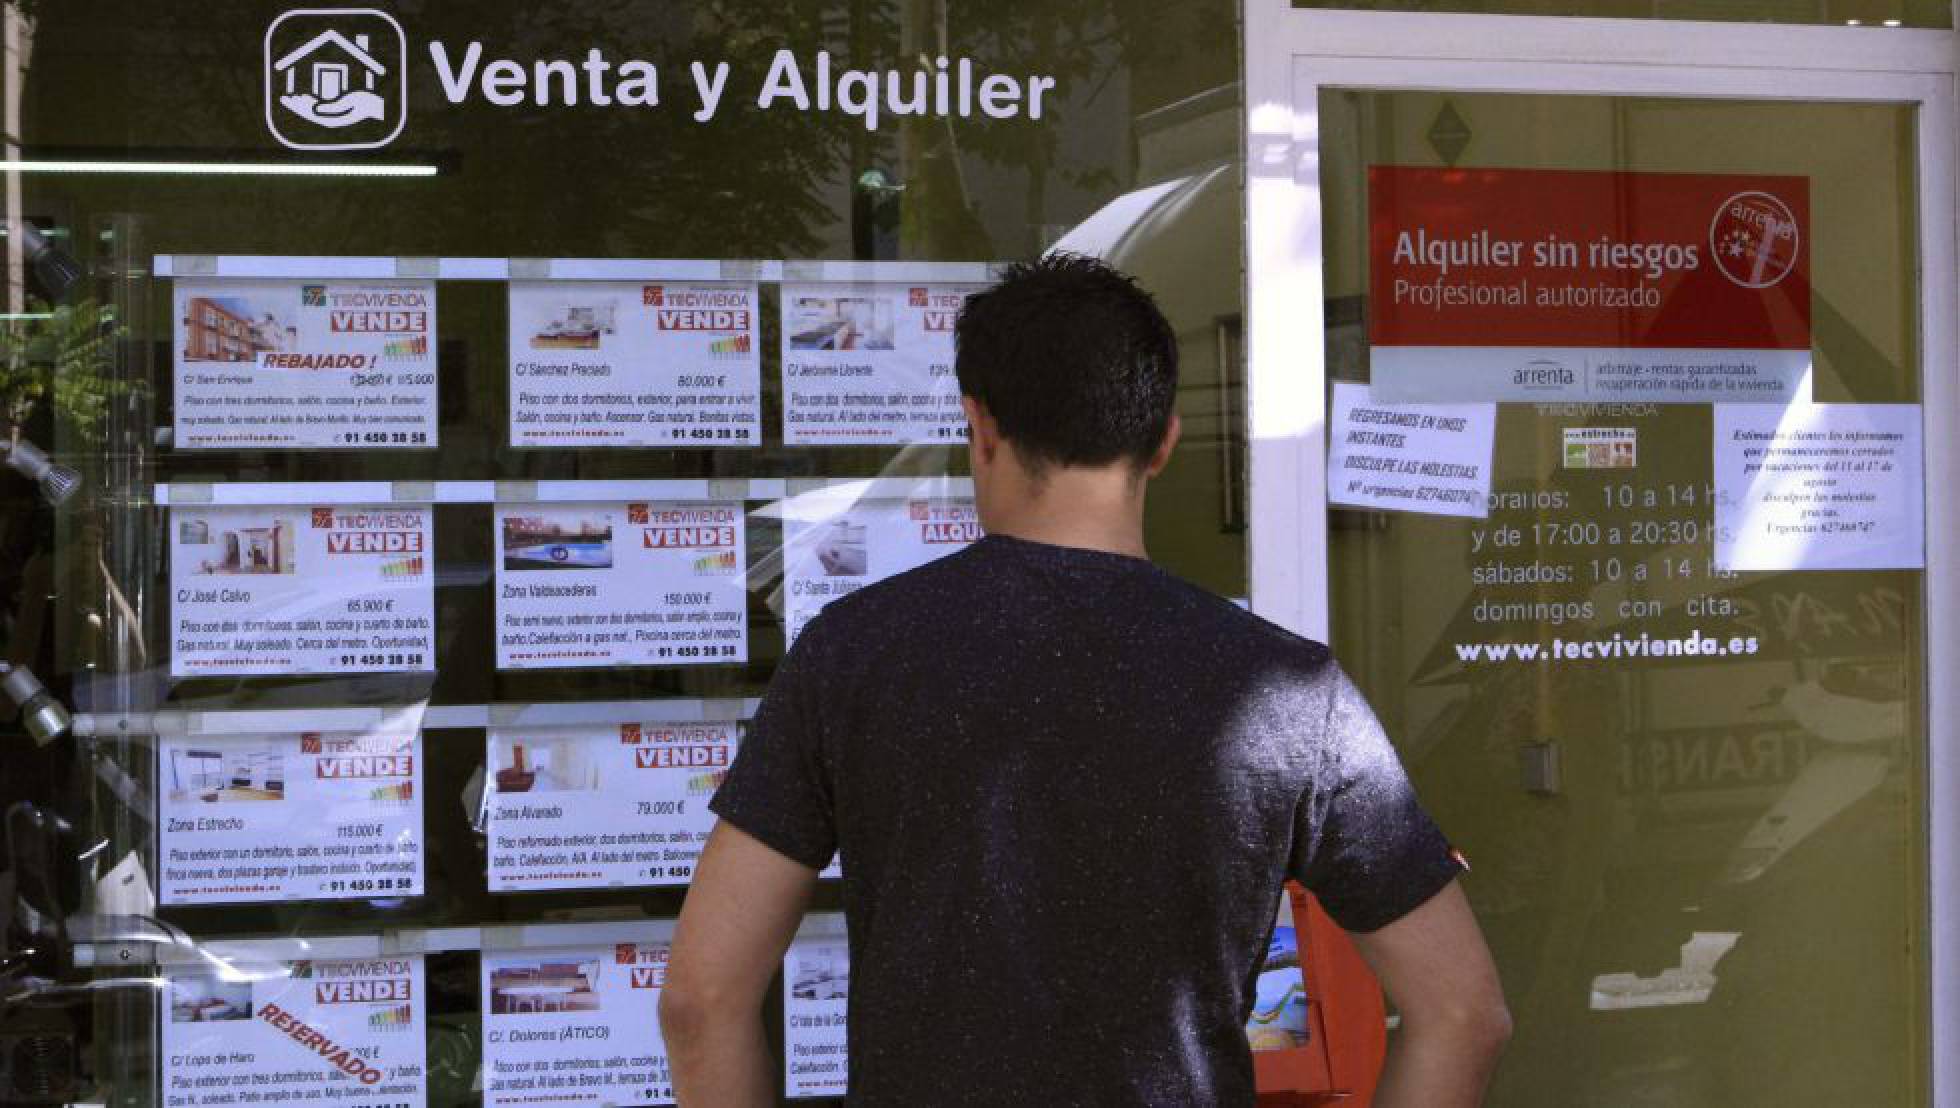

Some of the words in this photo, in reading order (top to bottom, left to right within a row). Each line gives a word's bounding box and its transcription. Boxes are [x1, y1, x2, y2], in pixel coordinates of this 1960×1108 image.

[429, 41, 658, 106] Venta
[691, 61, 730, 123] y
[757, 49, 1055, 130] Alquiler
[1394, 228, 1522, 274] Alquiler
[1533, 234, 1578, 268] sin
[1589, 237, 1699, 279] riesgos
[1395, 277, 1528, 311] Profesional
[1536, 283, 1661, 308] autorizado
[332, 312, 425, 331] VENDE
[659, 311, 748, 330] VENDE
[263, 354, 365, 369] REBAJADO
[1513, 367, 1574, 386] arrenta
[1688, 363, 1758, 379] garantizadas
[1709, 377, 1723, 389] de
[1725, 377, 1735, 389] la
[1737, 377, 1784, 390] vivienda
[1348, 408, 1420, 428] REGRESAMOS
[1420, 416, 1436, 429] EN
[1436, 417, 1467, 432] UNOS
[346, 432, 359, 442] 91
[672, 429, 685, 439] 91
[1743, 448, 1761, 458] que
[1344, 455, 1398, 472] DISCULPE
[1398, 459, 1419, 474] LAS
[1743, 462, 1762, 475] por
[1823, 461, 1839, 471] del
[1853, 461, 1865, 471] al
[1881, 461, 1893, 471] de
[1362, 484, 1414, 499] urgencias
[1603, 485, 1633, 507] 10
[1644, 490, 1655, 506] a
[1668, 484, 1694, 506] 14
[329, 532, 421, 552] VENDE
[645, 528, 734, 547] VENDE
[1472, 530, 1486, 552] y
[1494, 525, 1521, 546] de
[1533, 522, 1599, 545] 17:00
[1609, 528, 1621, 545] a
[1631, 522, 1697, 545] 20:30
[1472, 560, 1573, 585] sábados:
[1591, 559, 1622, 581] 10
[1634, 562, 1647, 581] a
[1664, 559, 1691, 578] 14
[177, 590, 189, 602] C/
[192, 589, 217, 602] José
[221, 590, 251, 602] Calvo
[502, 584, 526, 598] Zona
[384, 601, 395, 612] €
[1473, 600, 1594, 625] domingos
[1618, 600, 1661, 618] con
[1686, 594, 1739, 617] cita.
[698, 628, 712, 639] del
[658, 648, 673, 658] 91
[1456, 630, 1759, 661] www.tecvivienda.es
[341, 654, 355, 665] 91
[637, 747, 727, 768] VENDE
[318, 757, 412, 778] VENDE
[493, 807, 519, 820] Zona
[520, 806, 563, 818] Alvarado
[637, 801, 675, 814] 79.000
[677, 801, 685, 813] €
[167, 818, 195, 832] Zona
[197, 817, 243, 831] Estrecho
[650, 868, 664, 878] 91
[330, 882, 345, 893] 91
[317, 980, 410, 1003] VENDE
[257, 1002, 383, 1084] RESERVADO
[510, 1030, 556, 1042] Dolores
[185, 1055, 211, 1067] Lope
[214, 1053, 227, 1064] de
[229, 1053, 255, 1064] Haro
